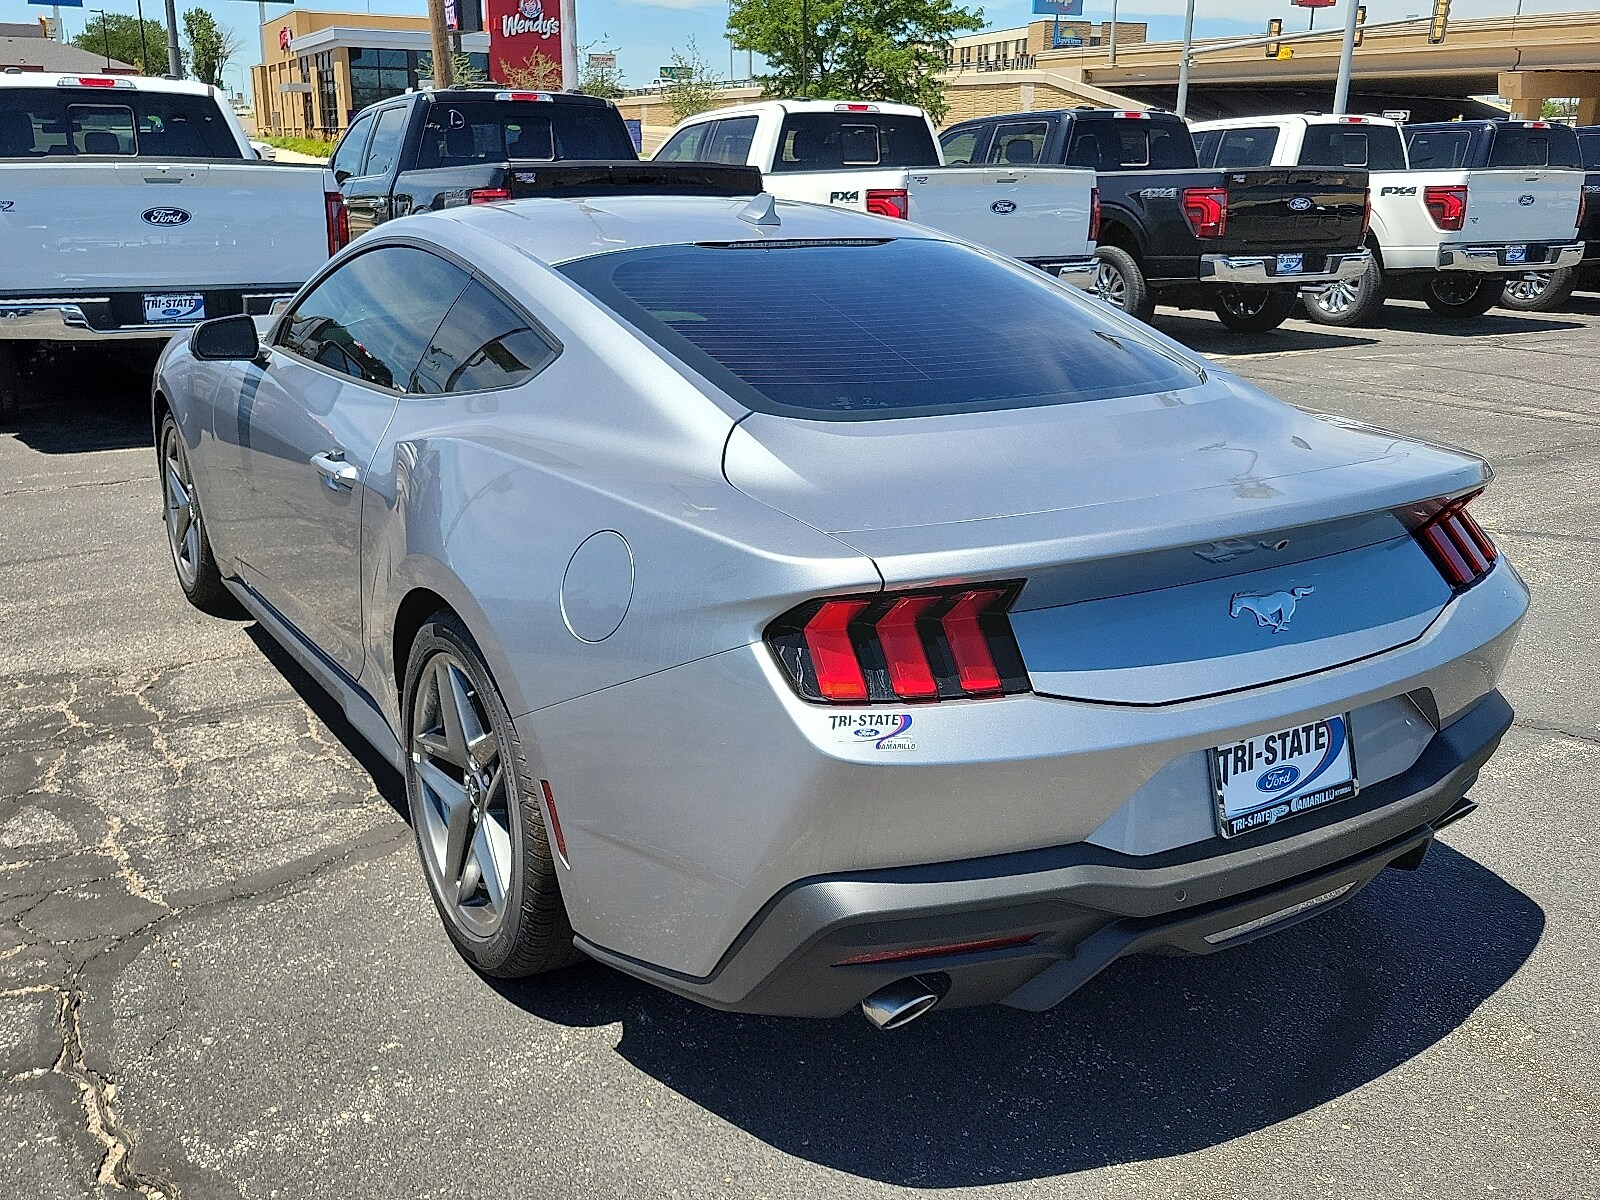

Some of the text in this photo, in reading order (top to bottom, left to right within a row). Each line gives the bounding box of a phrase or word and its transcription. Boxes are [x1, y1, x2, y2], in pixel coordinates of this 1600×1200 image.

[502, 13, 560, 39] Wendy's
[830, 190, 859, 203] FX4
[1380, 187, 1417, 196] FX4
[150, 209, 183, 223] Ford
[144, 298, 195, 310] TRI-STATE
[828, 714, 900, 730] TRI-STATE
[1219, 722, 1328, 786] TRI-STATE
[1265, 768, 1293, 789] Ford
[1230, 809, 1272, 834] TRI-STATE
[1296, 789, 1335, 811] AMARILLO
